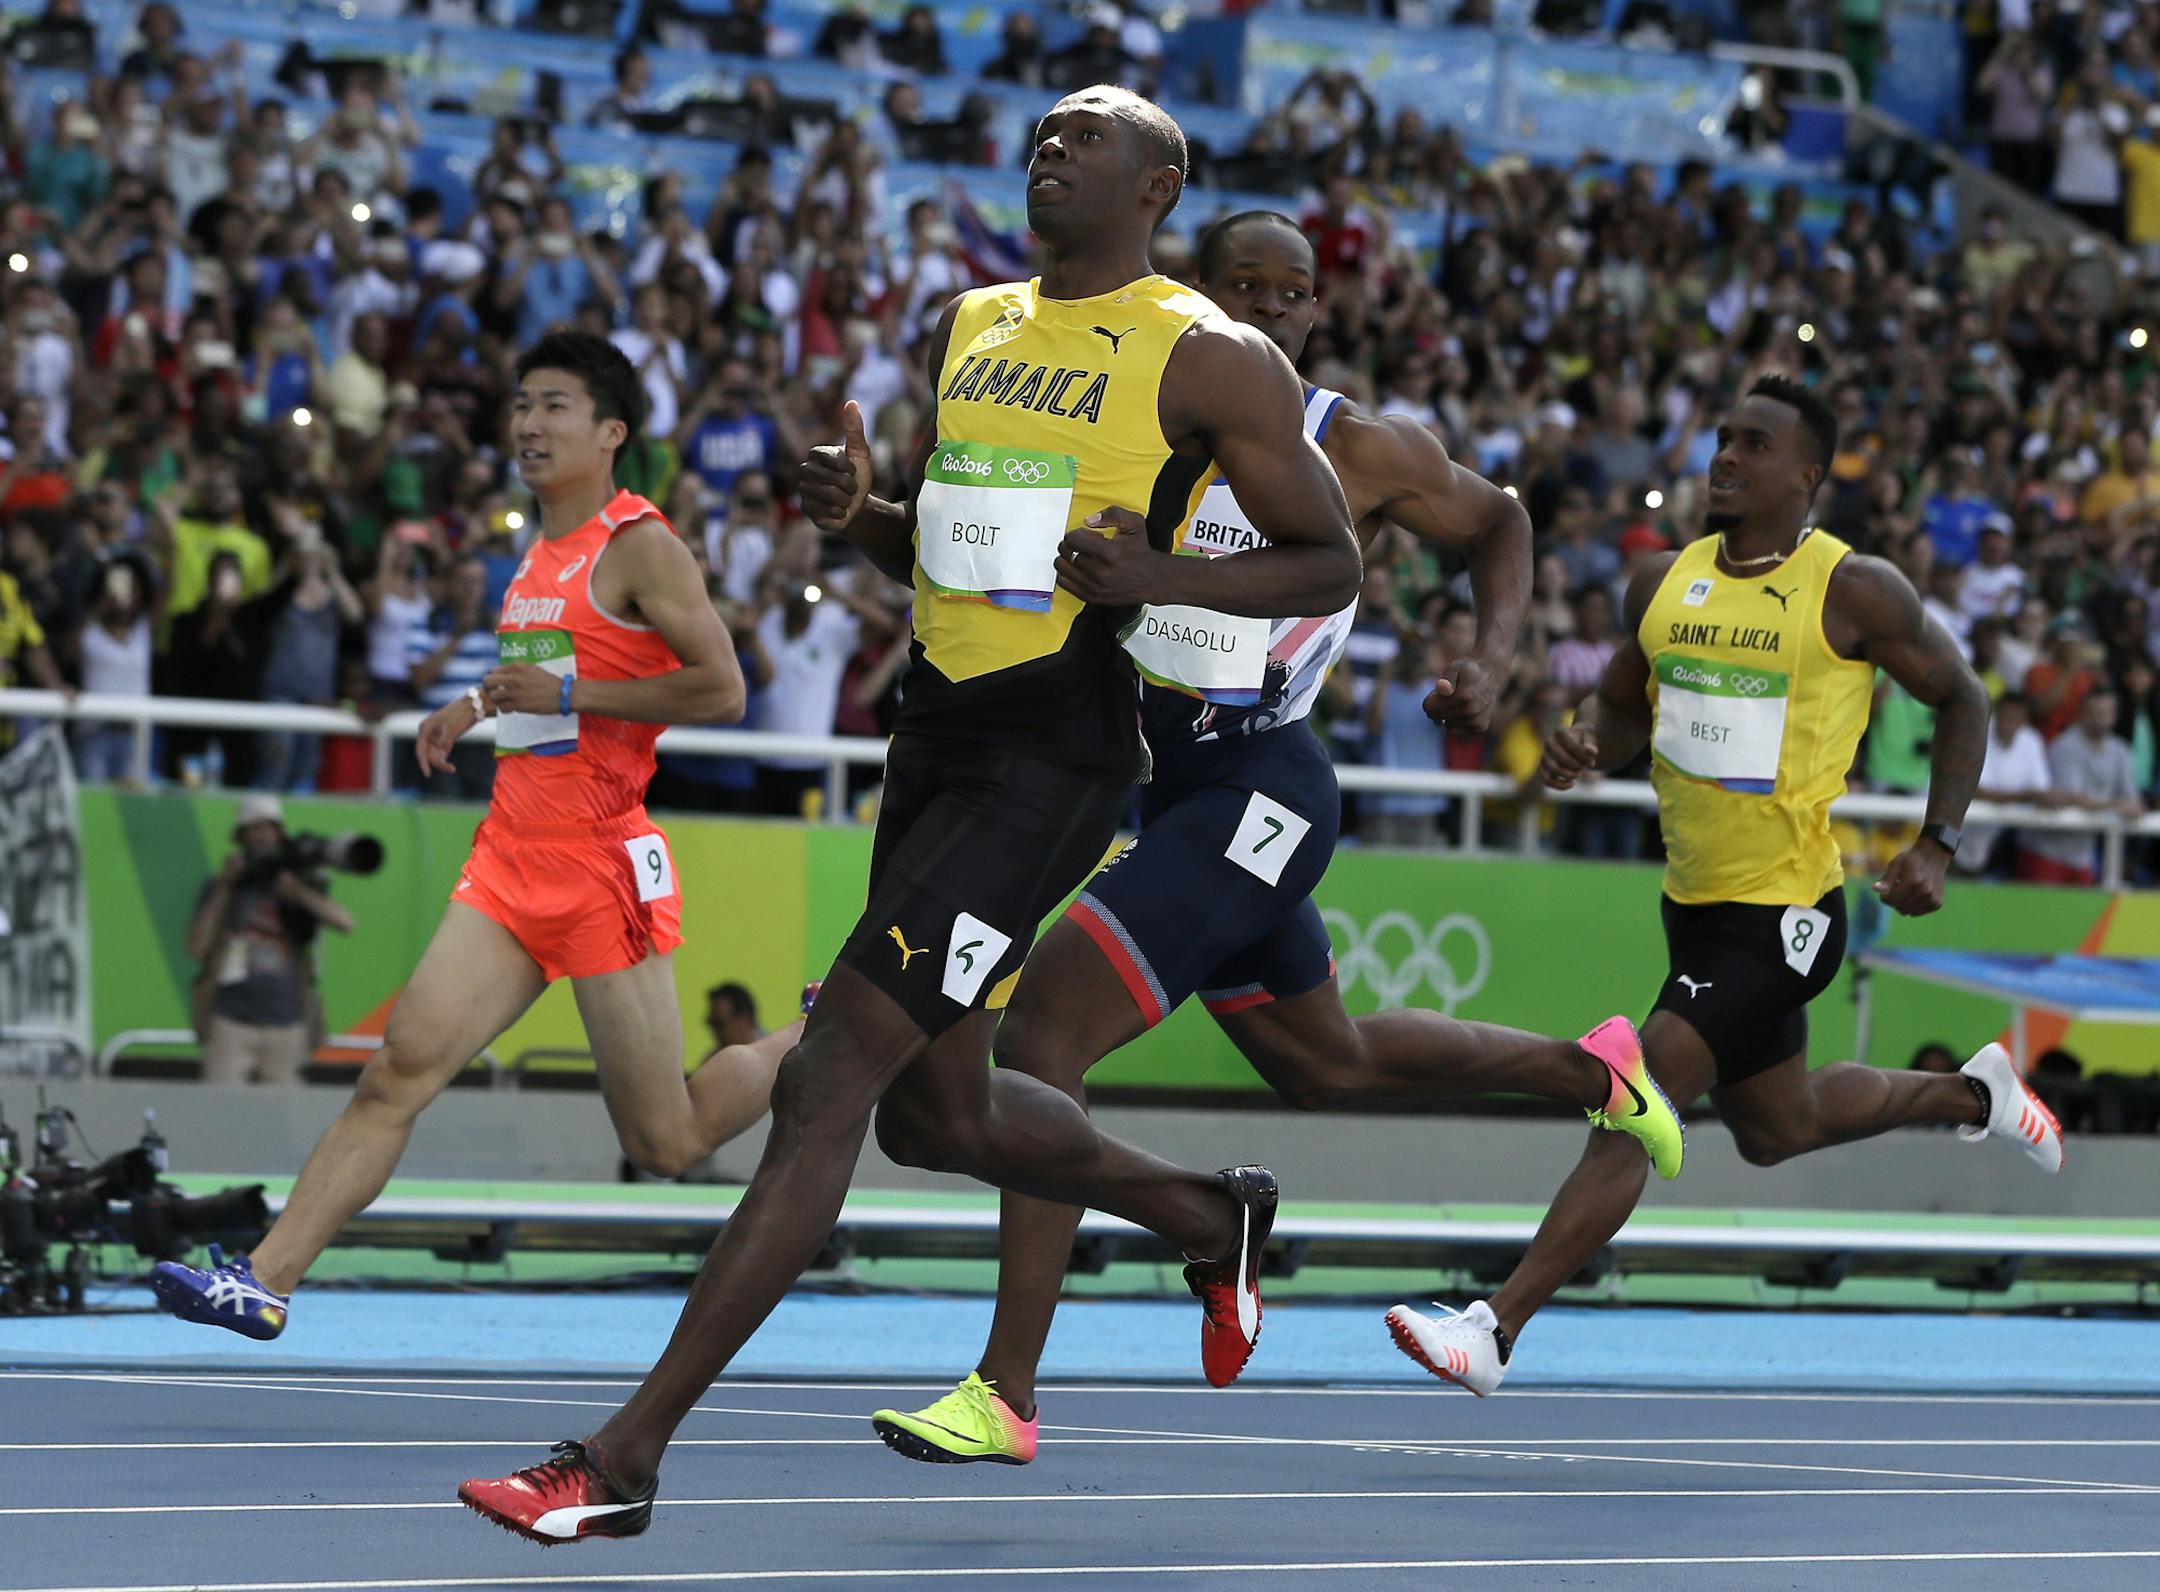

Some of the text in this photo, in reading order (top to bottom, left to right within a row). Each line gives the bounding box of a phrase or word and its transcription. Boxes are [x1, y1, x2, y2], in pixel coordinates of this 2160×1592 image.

[941, 356, 1109, 424] JAMAICA
[951, 522, 1001, 546] BOLT
[501, 591, 566, 629] Japan
[1146, 617, 1237, 653] DASAOLU
[1668, 622, 1780, 652] SAINT LUCIA
[1690, 721, 1731, 744] BEST
[1252, 815, 1284, 854] 7
[647, 849, 661, 885] 9
[1791, 918, 1814, 953] 8
[955, 940, 984, 975] 5
